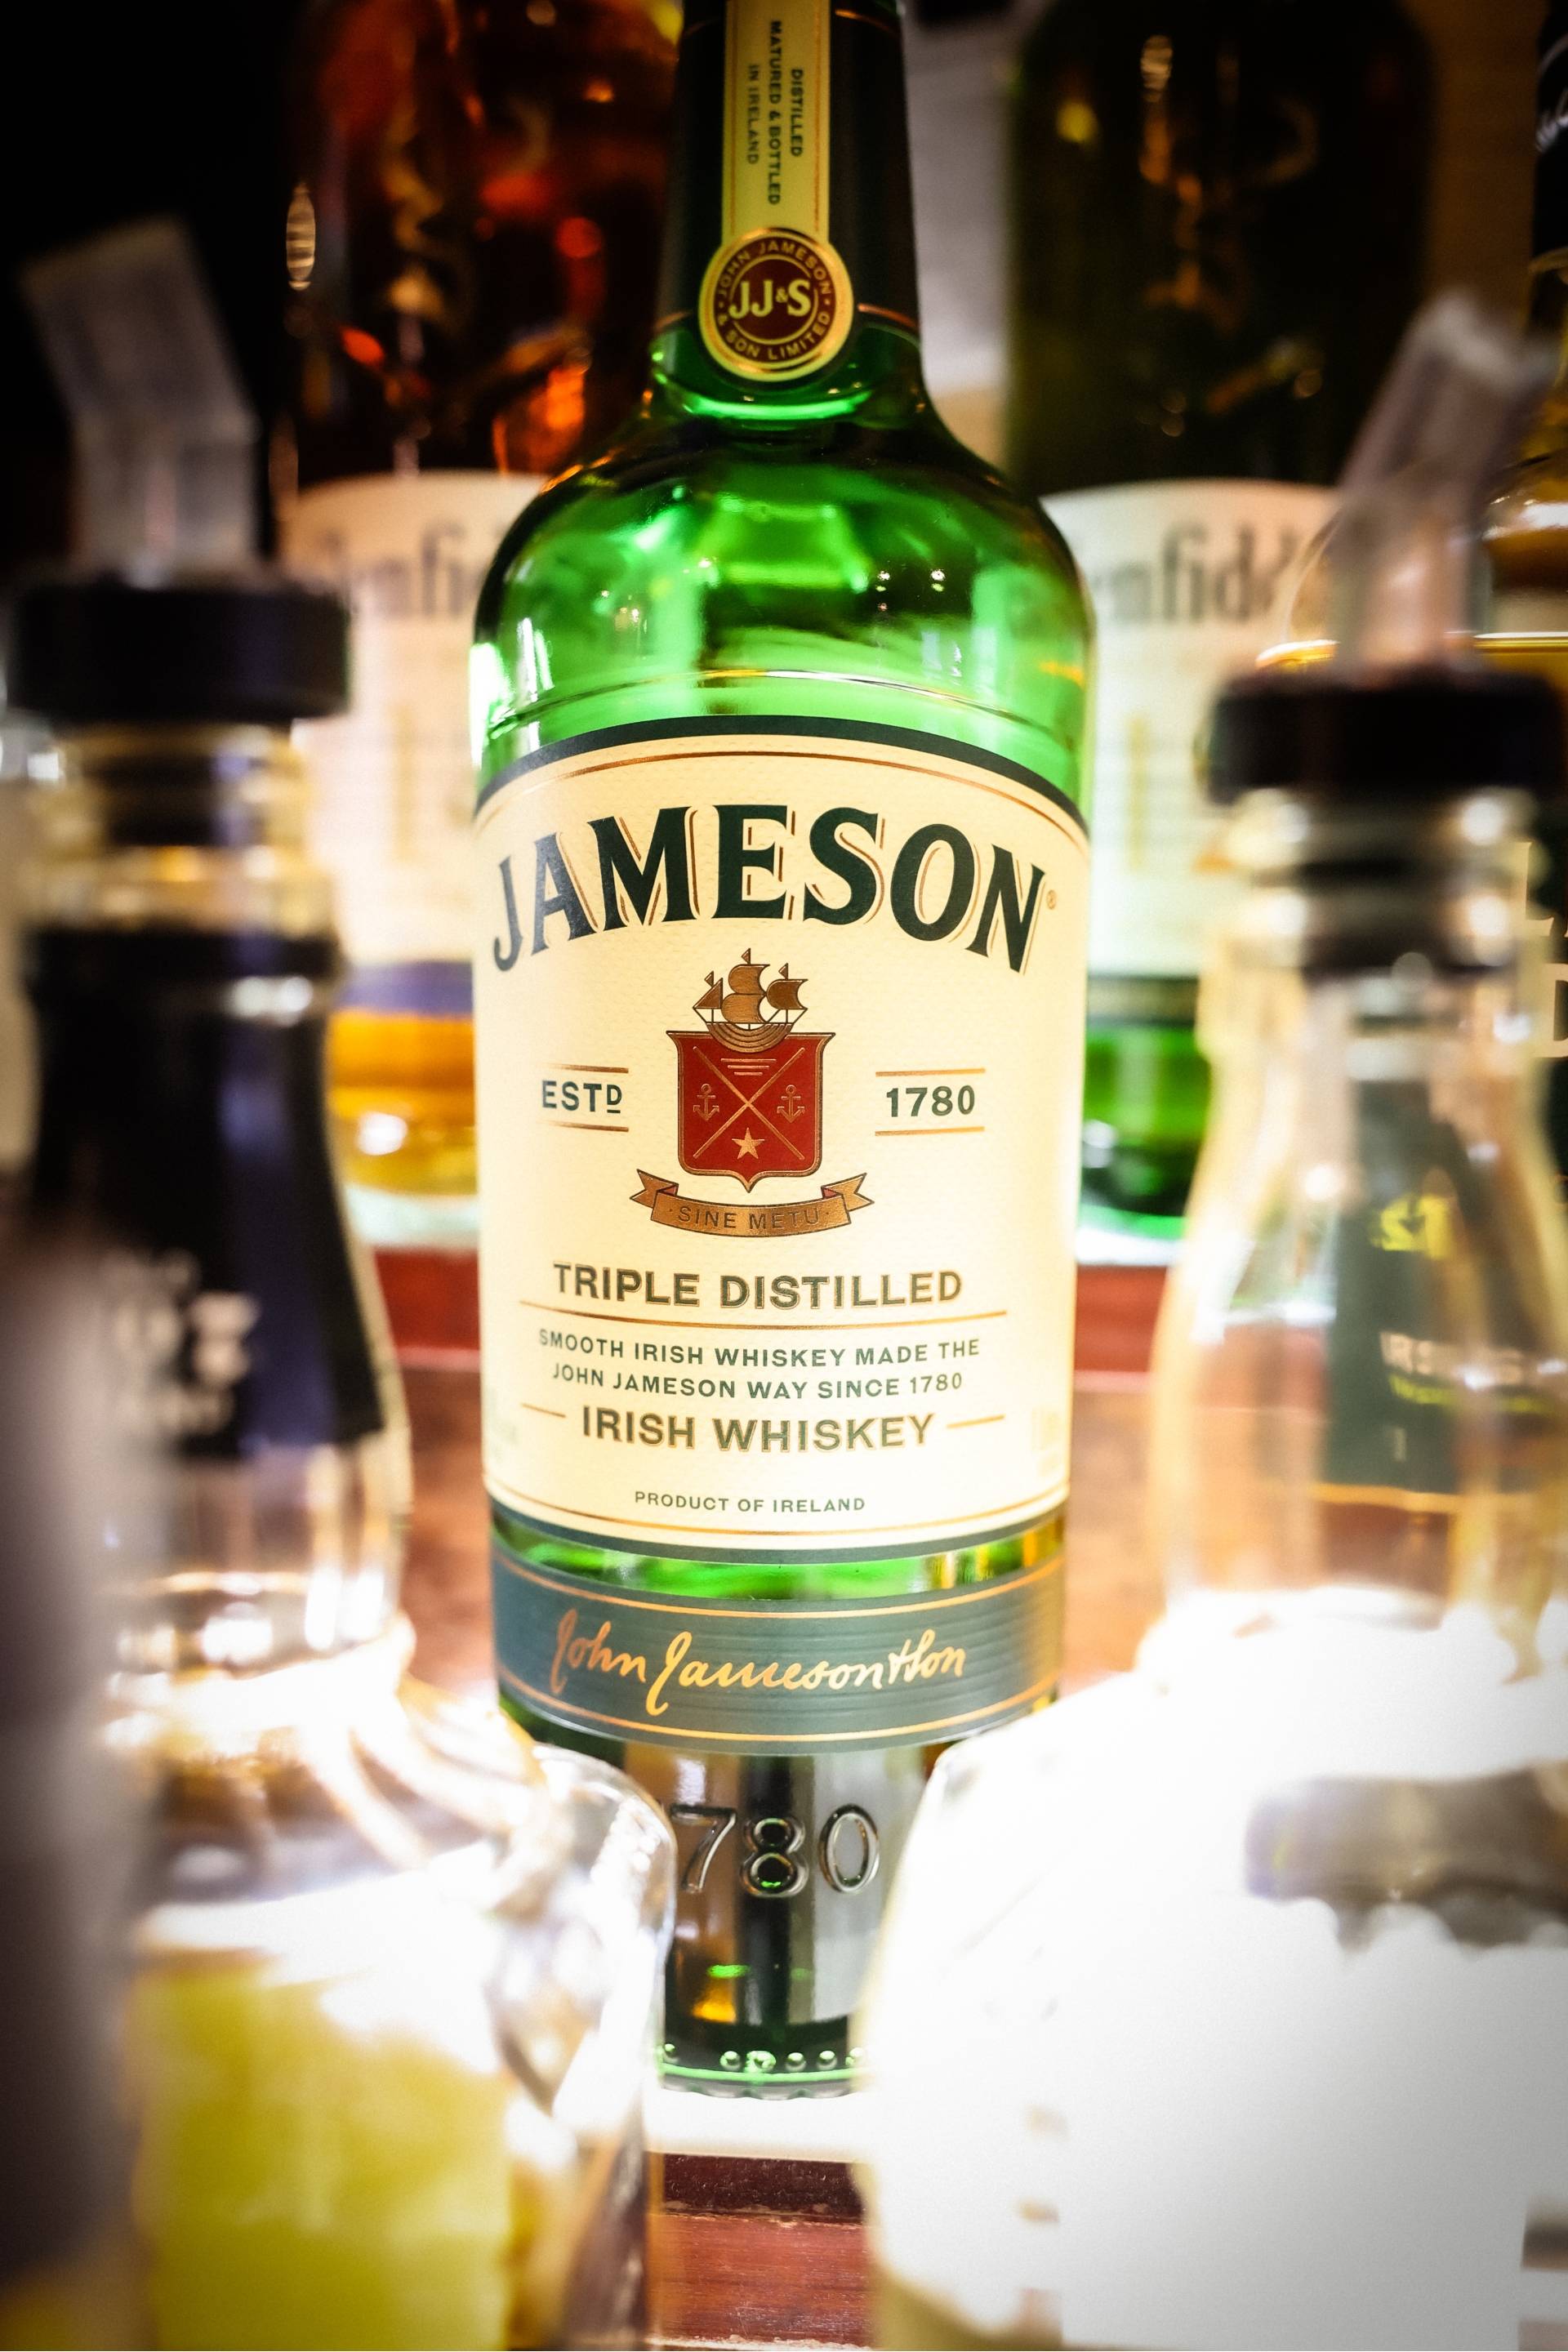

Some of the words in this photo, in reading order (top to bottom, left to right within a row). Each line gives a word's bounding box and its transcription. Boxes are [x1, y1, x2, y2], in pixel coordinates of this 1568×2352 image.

[747, 65, 760, 81] IN
[769, 20, 782, 105] MATURED
[746, 87, 760, 165] IRELAND
[768, 110, 781, 121] &
[791, 69, 804, 157] DISTILLED
[768, 126, 781, 205] BOTTLED
[718, 250, 751, 298] JOHN
[759, 240, 831, 294] JAMESON
[725, 329, 760, 358] SON
[768, 311, 831, 360] LIMITED
[541, 1080, 623, 1114] ESTD
[885, 1085, 976, 1118] 1780
[678, 1205, 737, 1229] SINE
[749, 1209, 820, 1230] METU
[553, 1263, 700, 1307] TRIPLE
[720, 1271, 962, 1310] DISTILLED
[539, 1328, 623, 1358] SMOOTH
[635, 1343, 703, 1365] IRISH
[715, 1348, 845, 1367] WHISKEY
[855, 1344, 928, 1365] MADE
[938, 1339, 979, 1359] THE
[553, 1362, 604, 1387] JOHN
[612, 1372, 736, 1398] JAMESON
[746, 1380, 808, 1399] WAY
[817, 1378, 899, 1399] SINCE
[910, 1372, 962, 1394] 1780
[582, 1405, 696, 1450] IRISH
[711, 1412, 936, 1453] WHISKEY
[635, 1491, 729, 1512] PRODUCT
[737, 1499, 764, 1512] OF
[773, 1498, 866, 1513] IRELAND
[550, 1608, 647, 1695] John
[645, 1631, 884, 1716] Jameson
